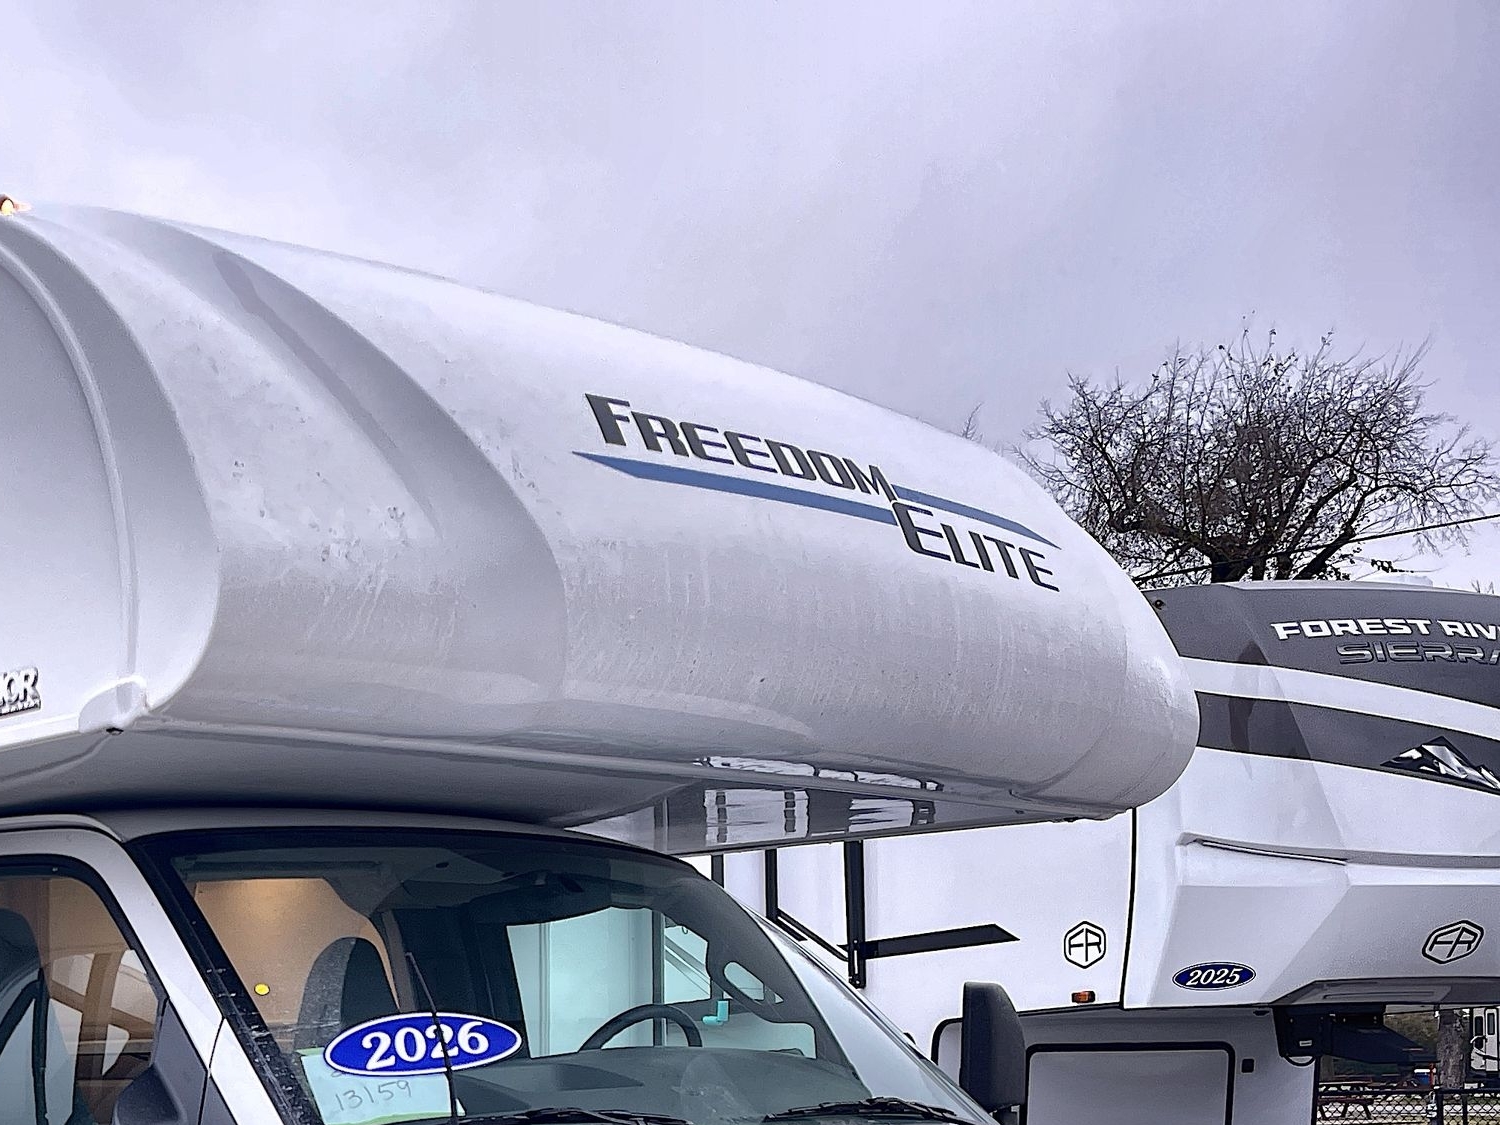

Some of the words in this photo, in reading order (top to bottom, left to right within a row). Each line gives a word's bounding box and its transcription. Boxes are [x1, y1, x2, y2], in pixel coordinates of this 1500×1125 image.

[585, 393, 896, 501] FREEDOM
[892, 500, 1060, 592] ELITE
[1271, 618, 1432, 640] FOREST
[1436, 619, 1500, 641] RIV
[1185, 968, 1243, 986] 2025
[361, 1021, 489, 1071] 2026
[335, 1079, 412, 1111] 13159
